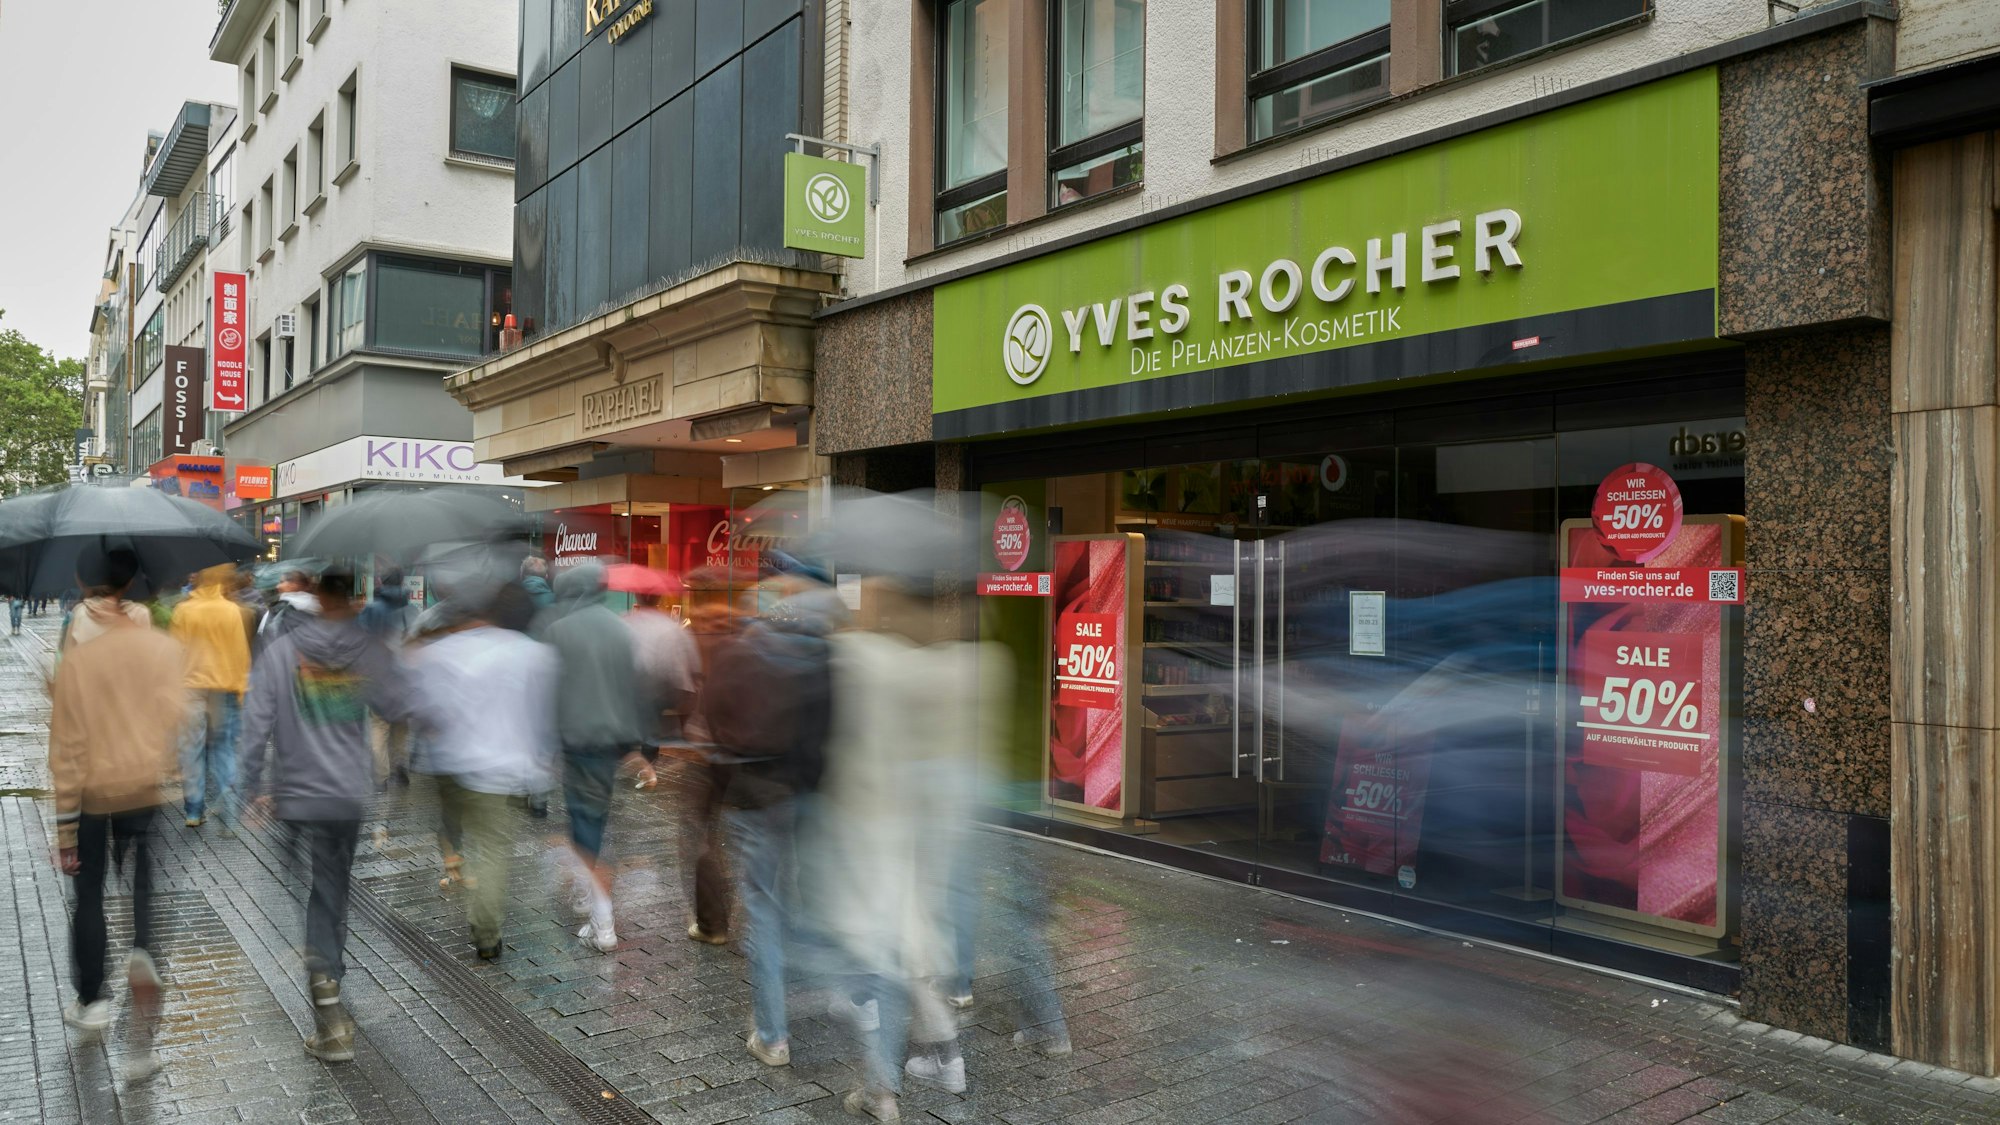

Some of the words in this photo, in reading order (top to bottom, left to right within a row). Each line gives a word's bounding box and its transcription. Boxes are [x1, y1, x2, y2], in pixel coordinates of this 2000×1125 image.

[794, 227, 818, 238] YVES
[821, 232, 860, 244] ROCHER
[1061, 283, 1190, 353] YVES
[1218, 208, 1523, 323] ROCHER
[217, 360, 243, 369] NOODLE
[220, 370, 241, 378] HOUSE
[175, 360, 189, 448] FOSSIL
[583, 380, 662, 429] RAPHAEL
[367, 440, 481, 472] KIKO
[178, 463, 222, 474] CHANGE
[366, 470, 400, 478] MAKE
[240, 476, 268, 486] PYLONES
[1626, 478, 1646, 488] WIR
[1607, 489, 1666, 502] SCHLIESSEN
[555, 522, 598, 555] Chancen
[1597, 571, 1628, 580] Finden
[1629, 572, 1643, 580] Sie
[1665, 571, 1680, 580] auf
[987, 582, 1032, 592] yves-rocher.de
[1584, 583, 1694, 598] yves-rocher.de
[1076, 622, 1102, 637] SALE
[1616, 646, 1670, 668] SALE
[1069, 684, 1096, 692] AUSGEWÄHLTE
[1602, 734, 1657, 748] AUSGEWÄHLTE
[1658, 741, 1699, 752] PRODUKTE
[1375, 753, 1393, 763] WIR
[1353, 764, 1410, 781] SCHLIESSEN
